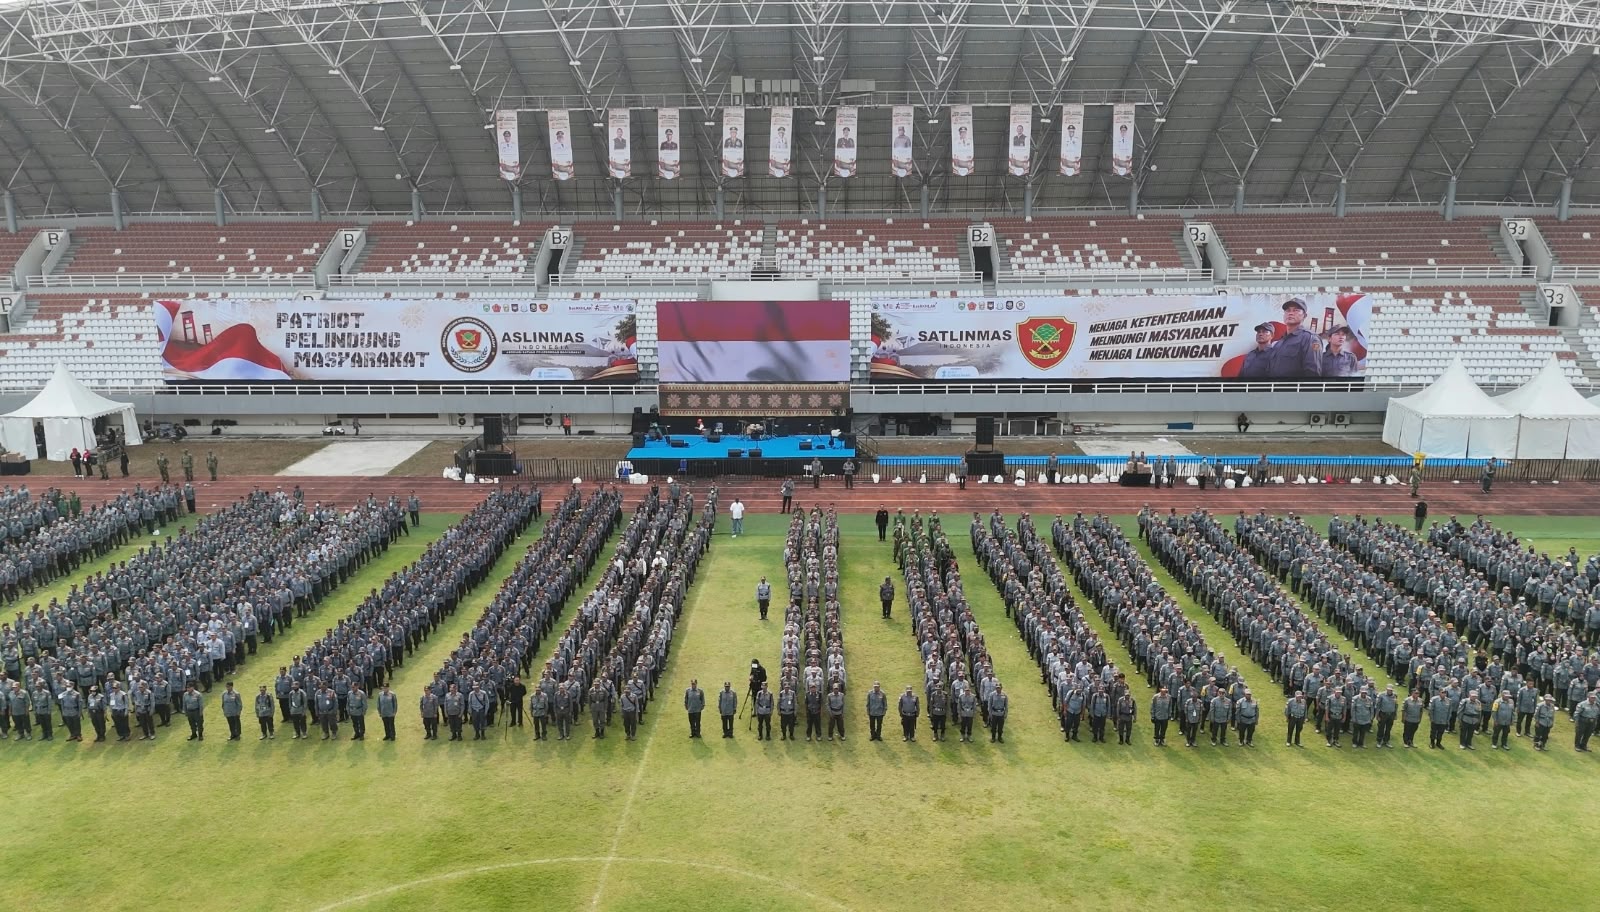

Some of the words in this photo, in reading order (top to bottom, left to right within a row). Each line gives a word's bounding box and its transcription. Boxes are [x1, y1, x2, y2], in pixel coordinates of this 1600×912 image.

[972, 229, 988, 242] B2
[1189, 227, 1206, 241] B3
[1507, 222, 1525, 235] B3
[552, 231, 568, 245] B2
[1544, 288, 1564, 304] B3
[276, 312, 364, 328] PATRIOT
[1088, 320, 1127, 333] MENJAGA
[1130, 306, 1227, 329] KETENTERAMAN
[285, 332, 401, 349] PELINDUNG
[501, 331, 585, 343] ASLINMAS
[918, 329, 1012, 342] SATLINMAS
[1090, 331, 1146, 346] MELINDUNGI
[1149, 323, 1239, 342] MASYARAKAT
[294, 351, 429, 367] MASYARAKAT
[1088, 348, 1133, 361] MENJAGA
[1135, 343, 1223, 360] LINGKUNGAN
